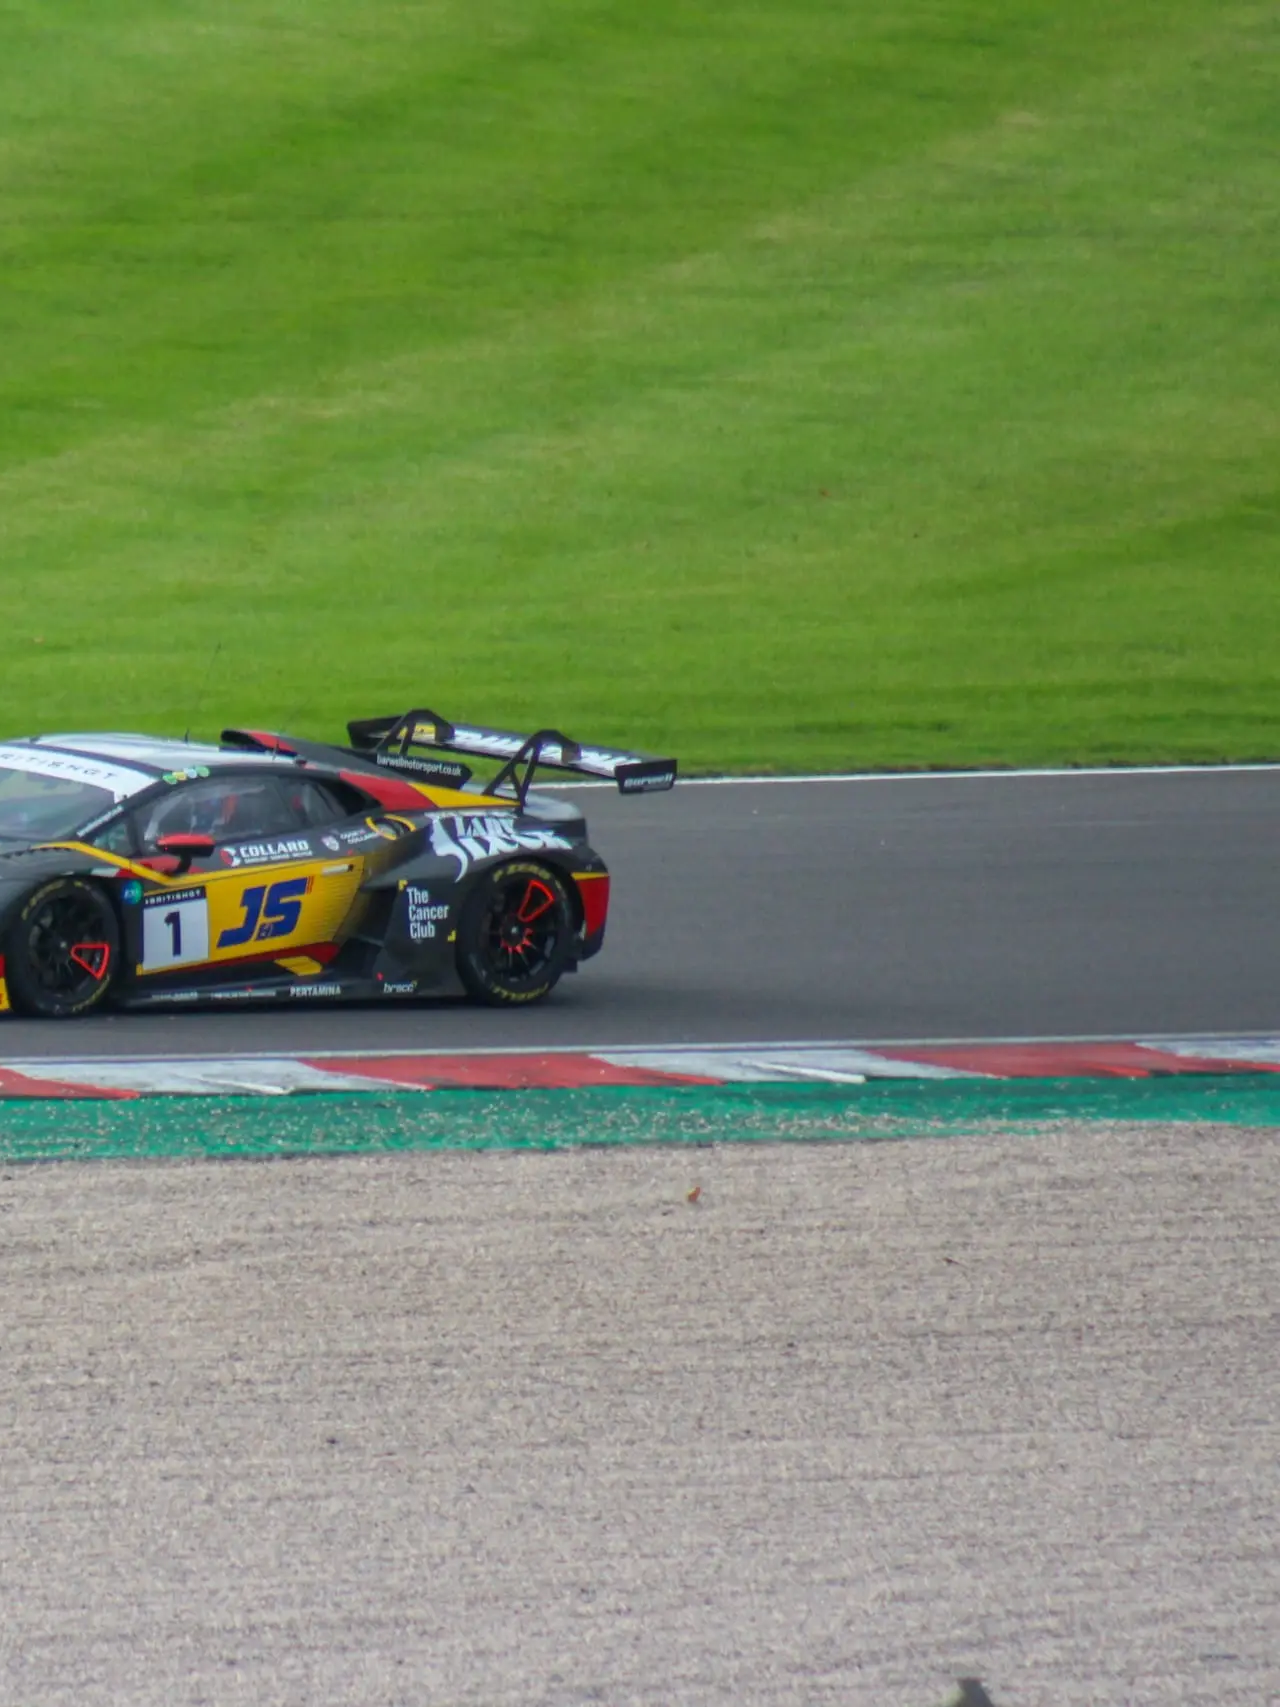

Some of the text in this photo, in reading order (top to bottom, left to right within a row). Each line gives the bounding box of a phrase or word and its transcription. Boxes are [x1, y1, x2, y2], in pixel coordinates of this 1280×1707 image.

[239, 839, 309, 859] COLLARD
[406, 888, 429, 904] The
[216, 876, 308, 949] JS
[408, 904, 450, 922] Cancer
[164, 911, 182, 957] 1
[410, 921, 436, 938] Club
[289, 985, 342, 997] PERTAMINA
